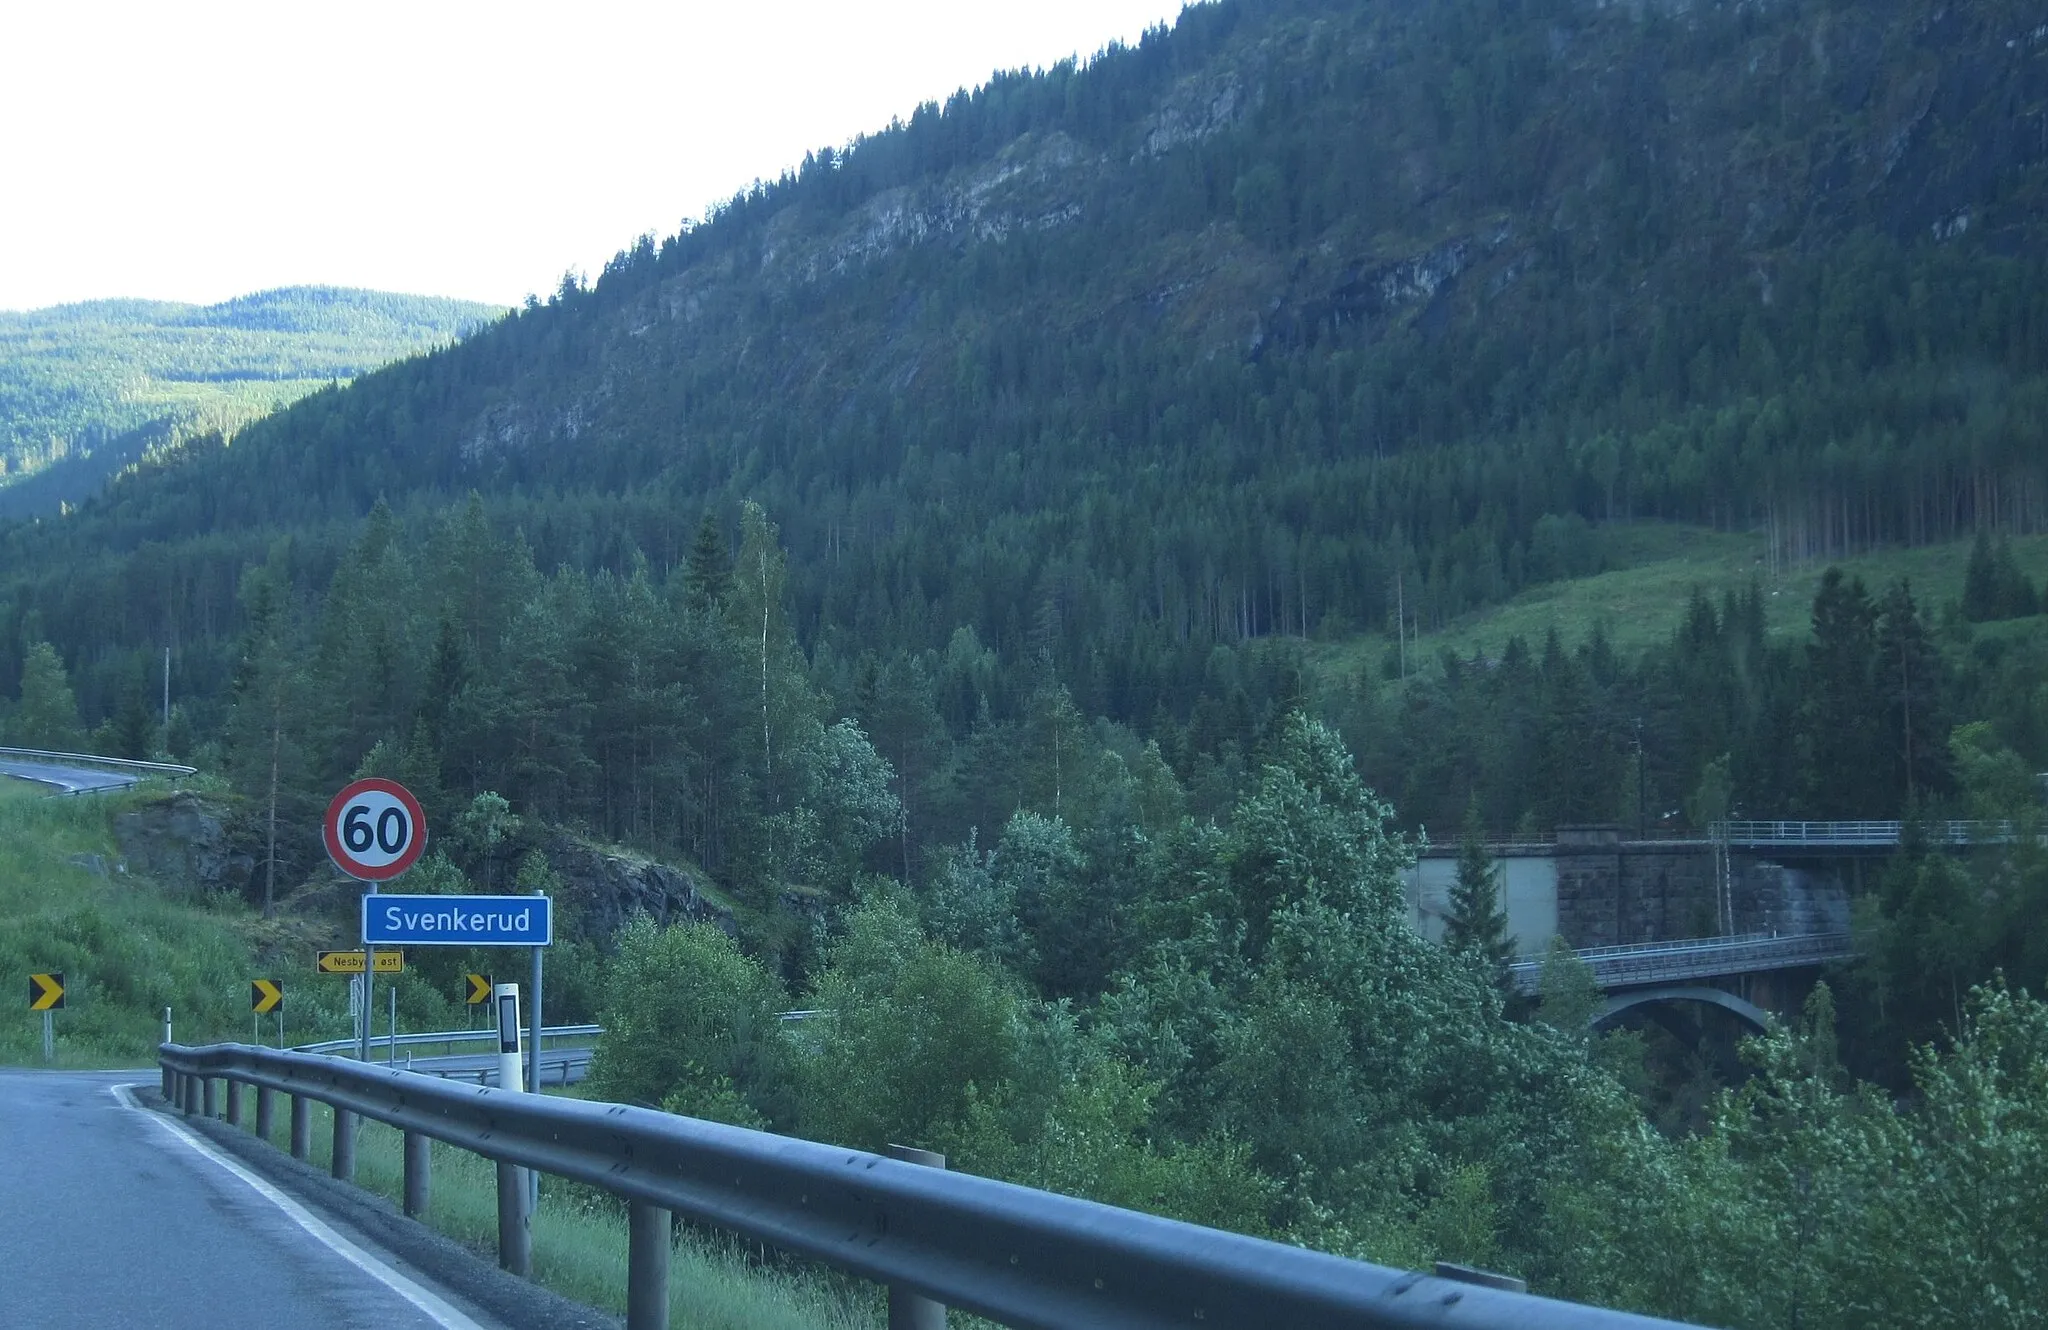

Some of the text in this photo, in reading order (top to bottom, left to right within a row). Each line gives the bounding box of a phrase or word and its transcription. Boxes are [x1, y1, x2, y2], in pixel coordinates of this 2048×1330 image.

[343, 806, 408, 854] 60
[385, 907, 530, 932] Svenkerud
[334, 957, 397, 967] Nesby øst
